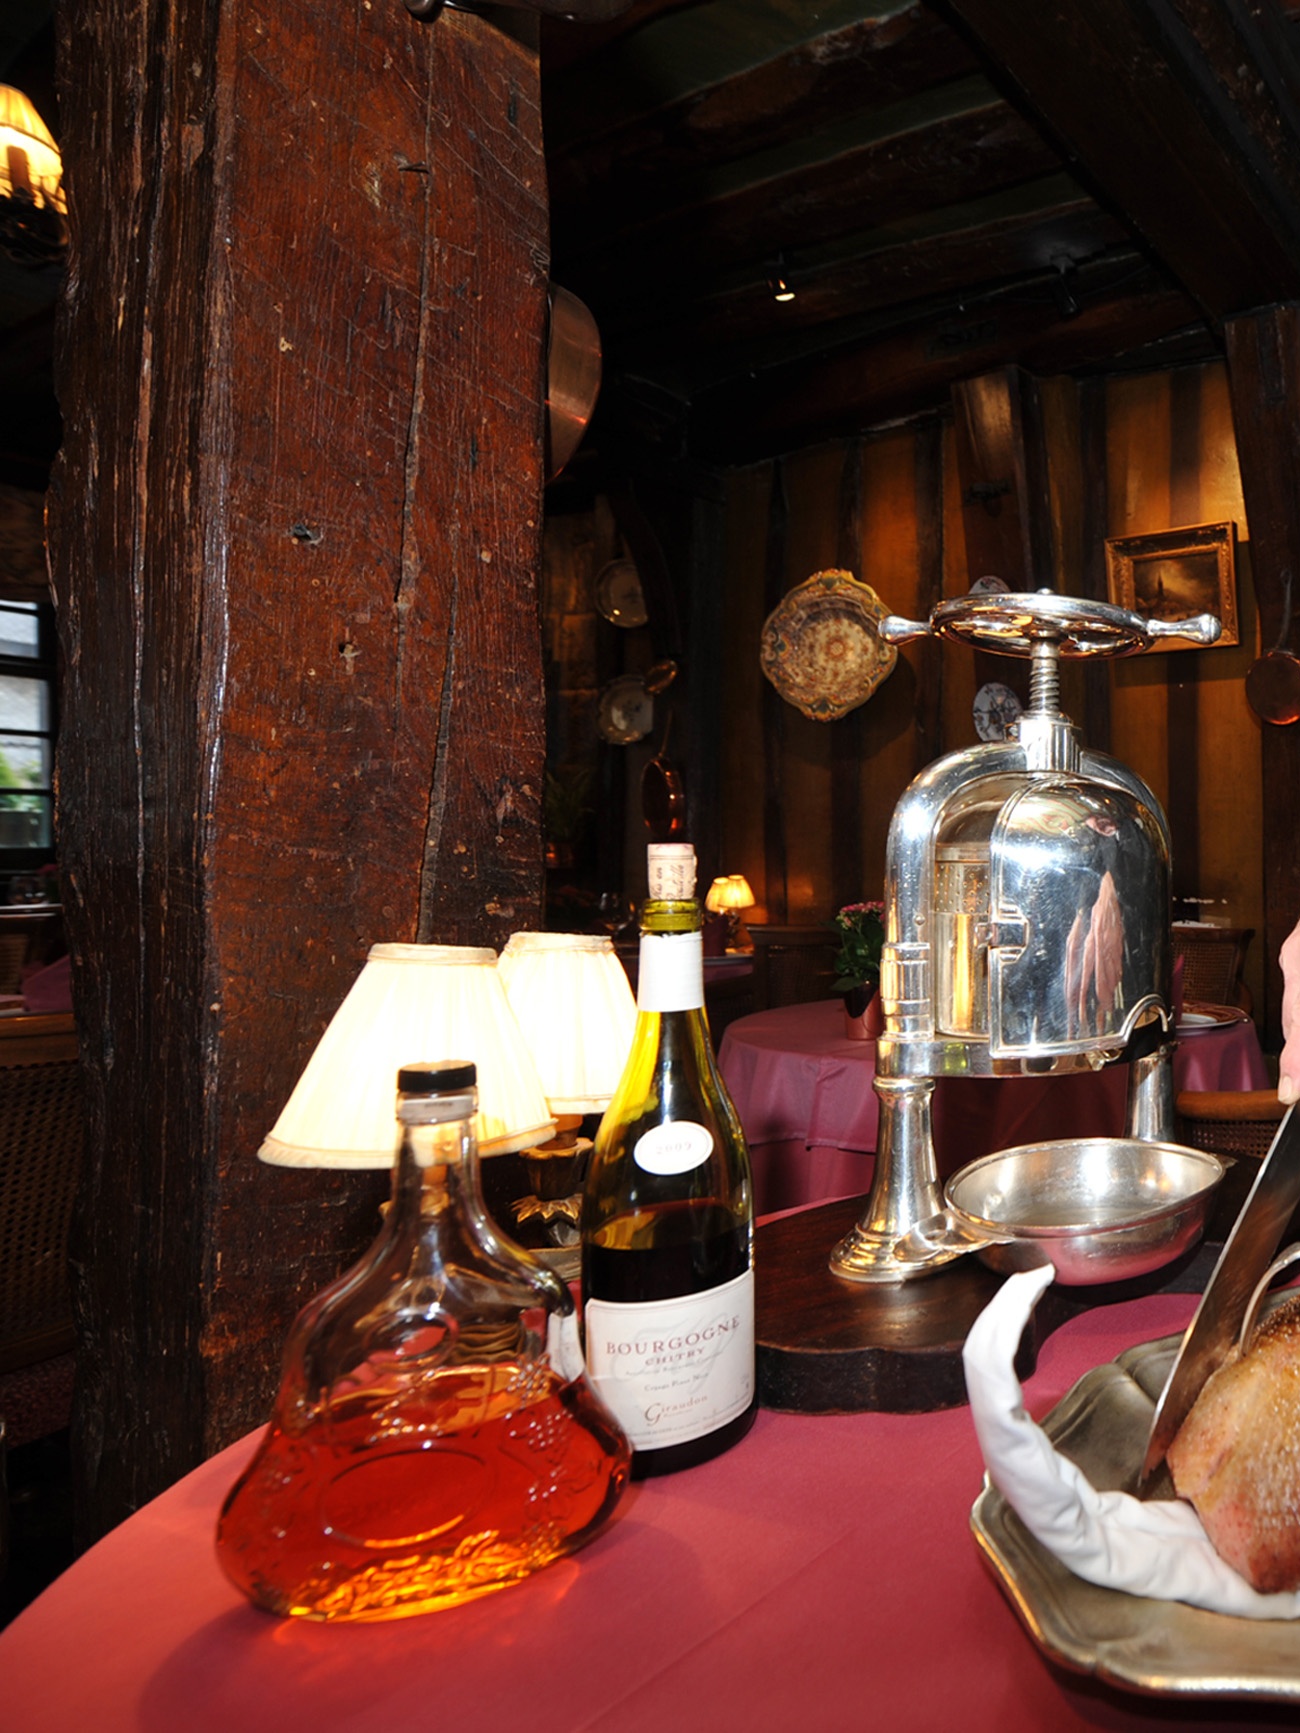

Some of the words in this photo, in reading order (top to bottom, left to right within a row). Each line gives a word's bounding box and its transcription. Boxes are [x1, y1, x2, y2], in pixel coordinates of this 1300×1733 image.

[655, 1140, 692, 1155] 2009
[606, 1314, 741, 1356] BOURGOGNE
[644, 1346, 706, 1366] CHITRY
[643, 1394, 708, 1427] Giraudon
